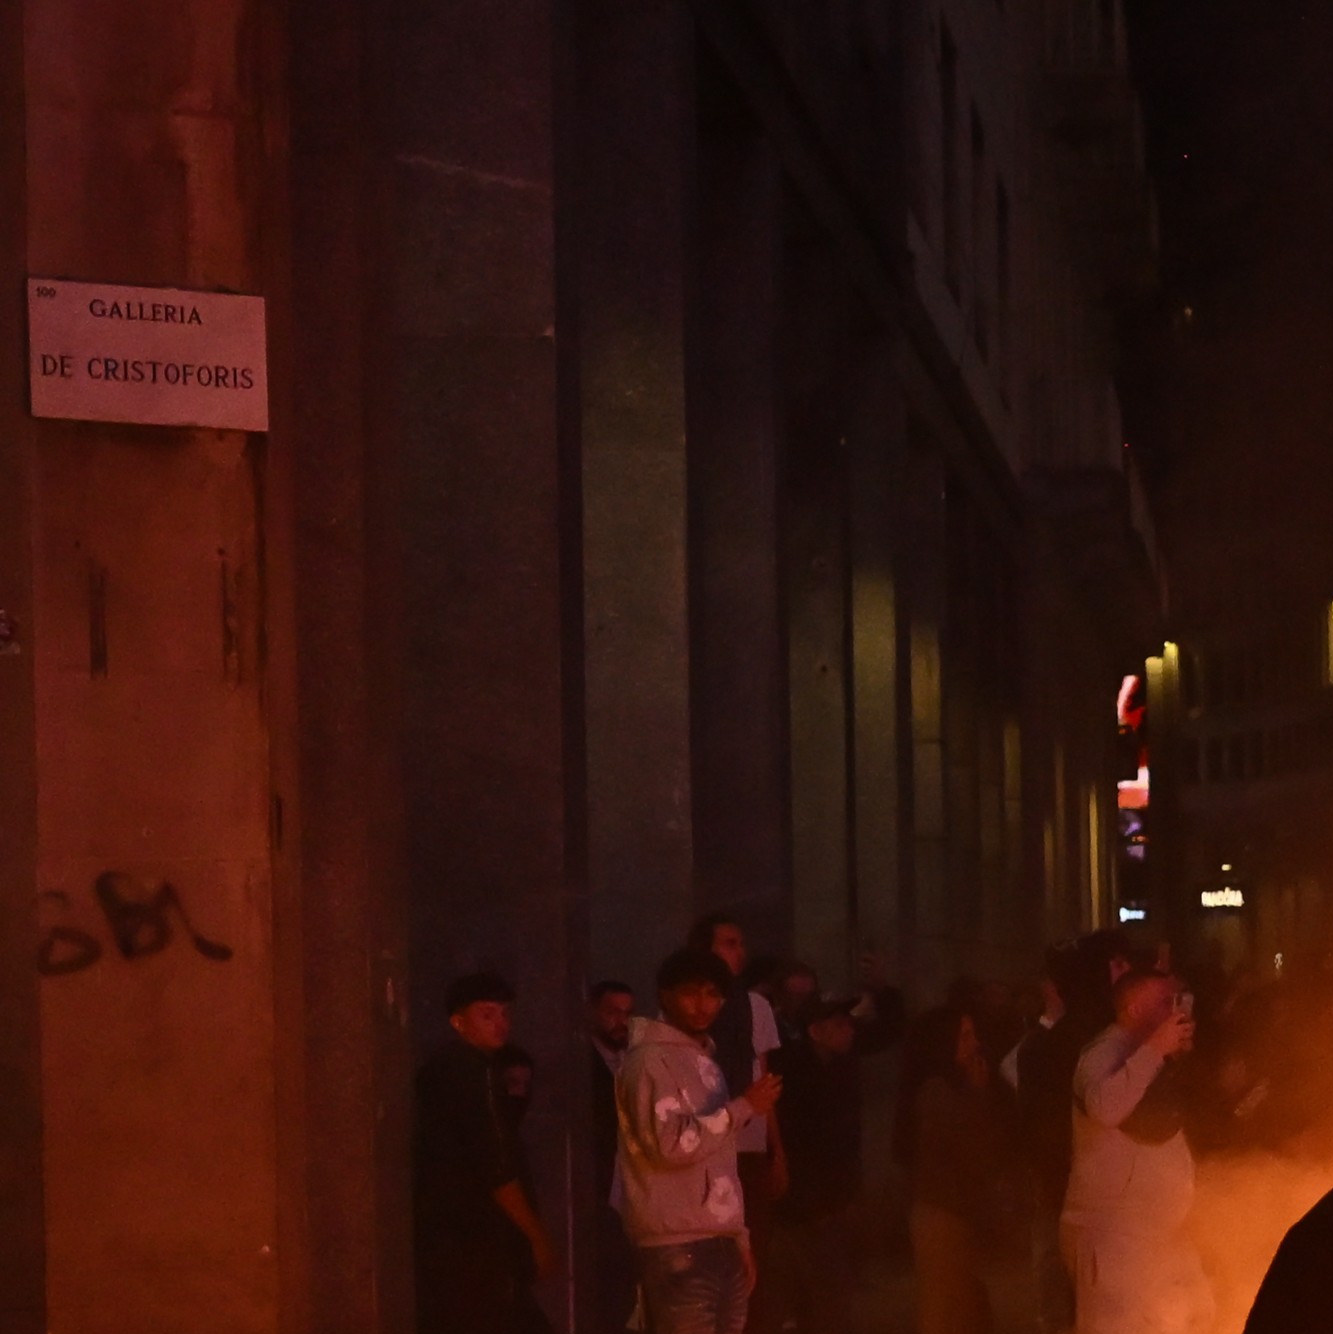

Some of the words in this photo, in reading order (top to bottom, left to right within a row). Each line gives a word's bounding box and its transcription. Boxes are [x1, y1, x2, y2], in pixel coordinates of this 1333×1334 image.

[89, 299, 202, 325] GALLERIA
[41, 354, 73, 378] DE
[87, 358, 254, 390] CRISTOFORIS
